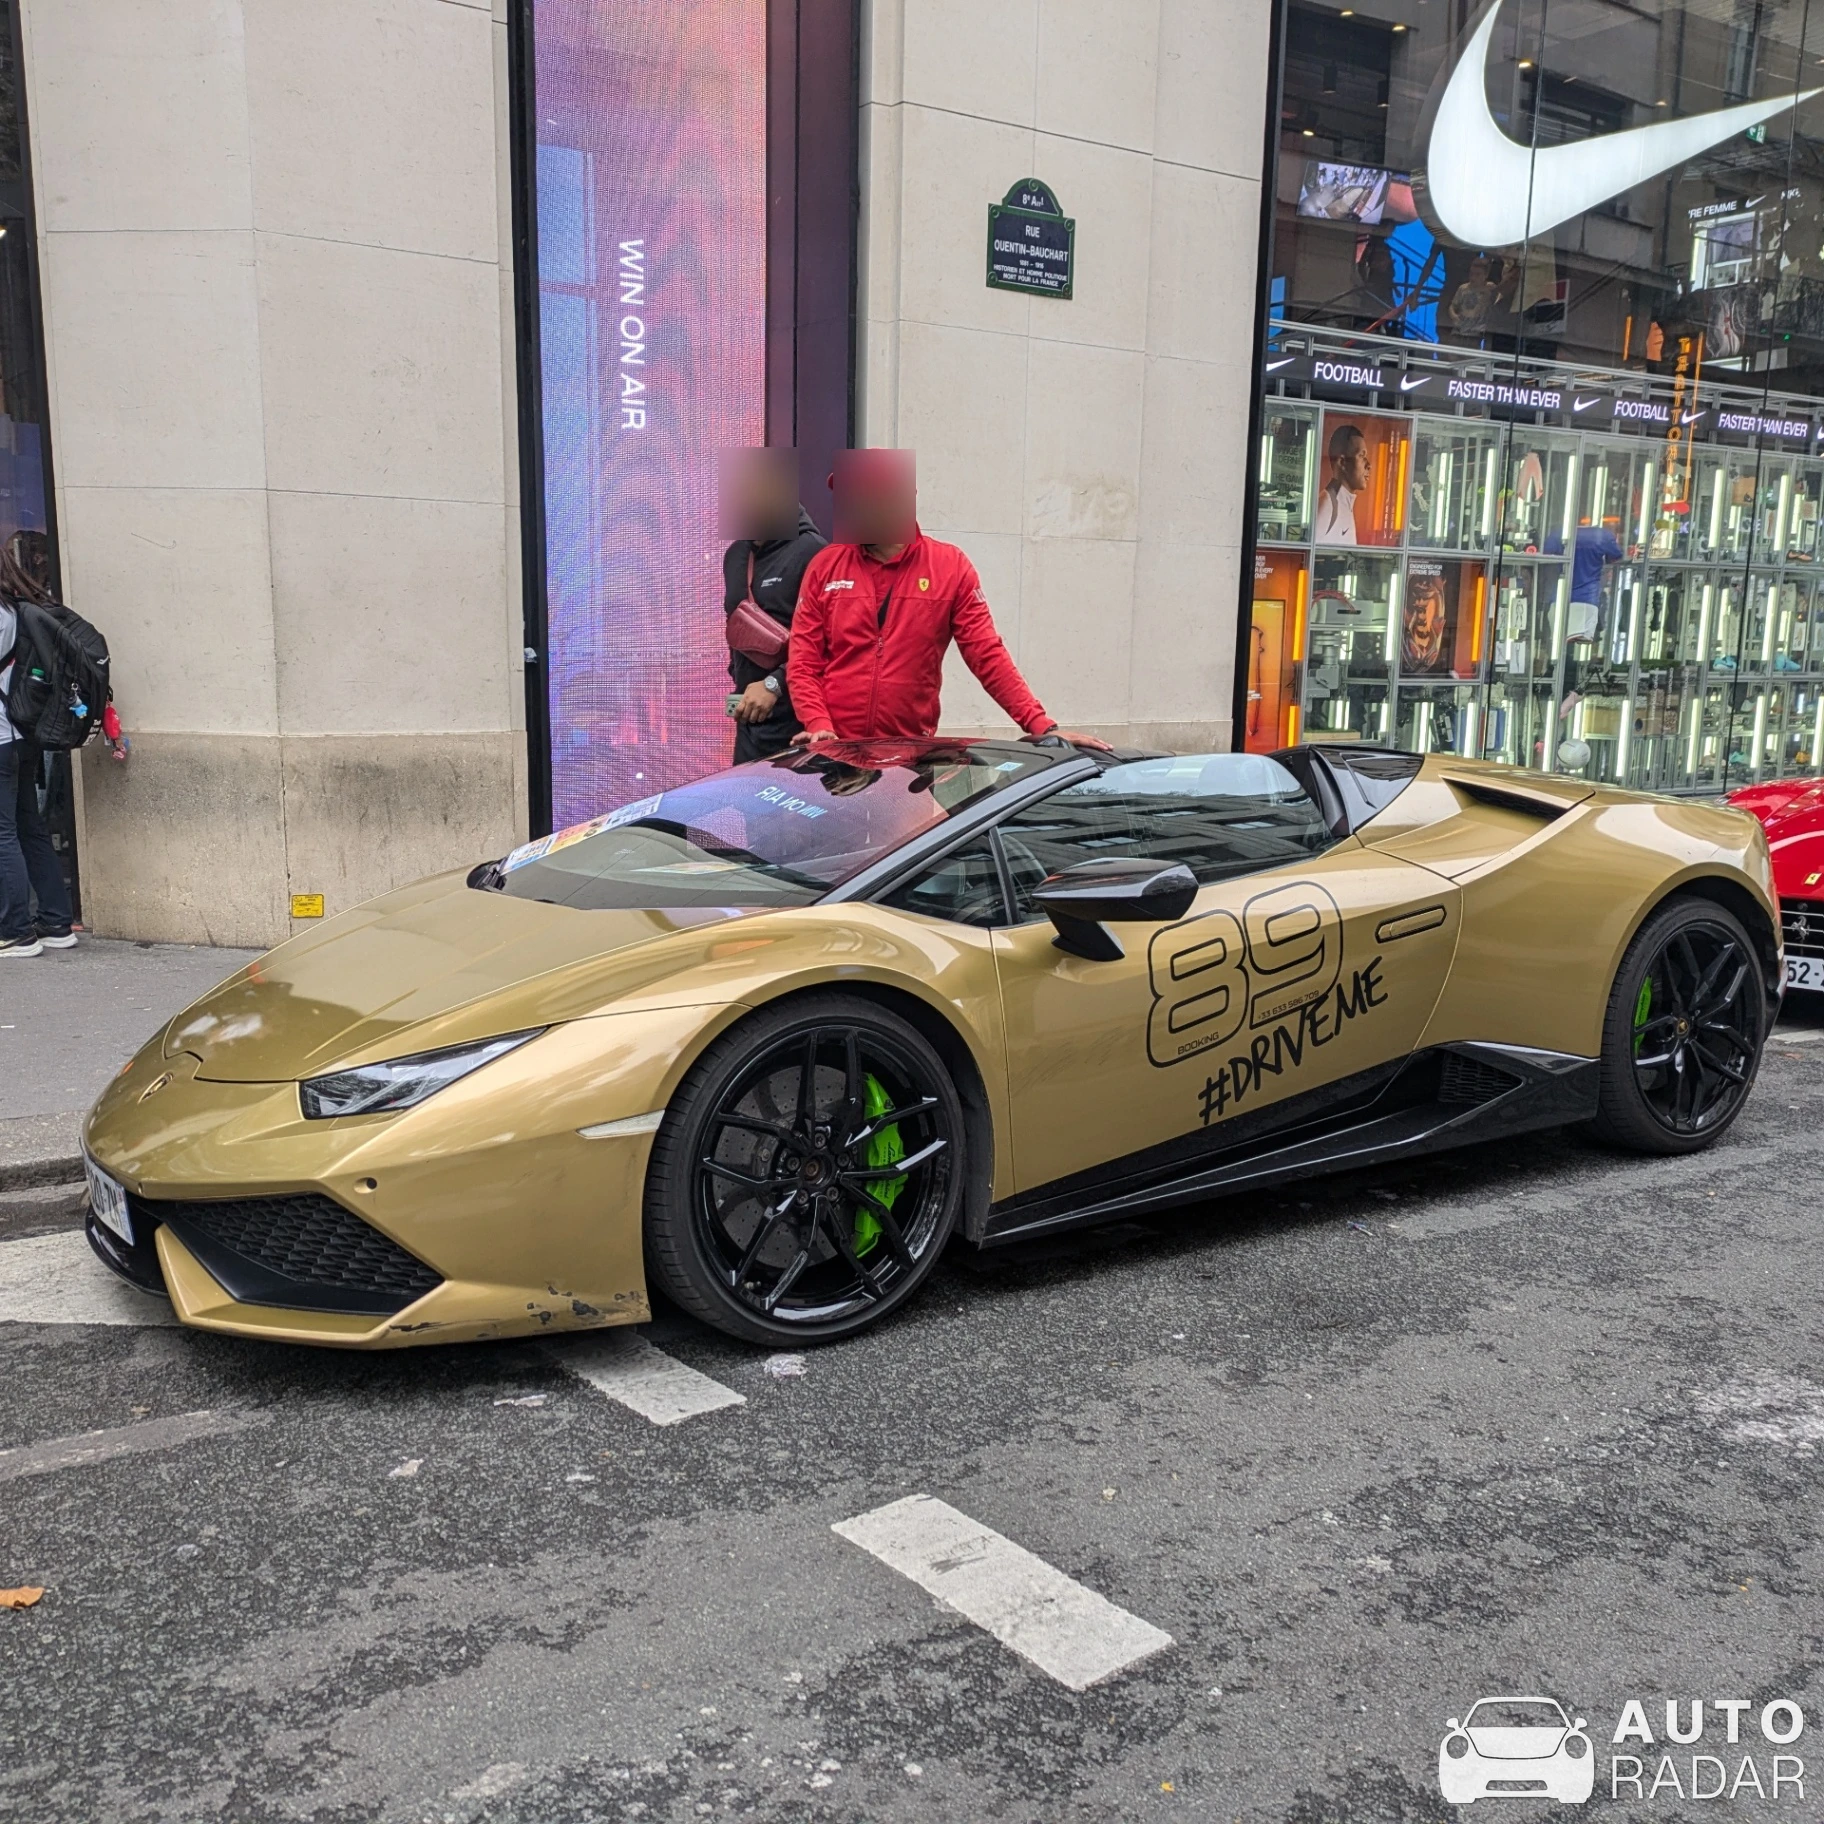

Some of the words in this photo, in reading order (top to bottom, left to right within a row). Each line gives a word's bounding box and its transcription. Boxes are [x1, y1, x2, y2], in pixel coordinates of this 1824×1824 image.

[1703, 200, 1737, 216] FEMME
[1025, 225, 1041, 238] RUE
[994, 239, 1069, 262] QUENTIN-BAUCHART
[618, 239, 645, 305] WIN
[993, 264, 1018, 273] HISTORIEN
[1019, 267, 1025, 275] ET
[1018, 274, 1031, 282] POUR
[1040, 278, 1059, 287] FRANCE
[619, 315, 645, 365] ON
[1314, 361, 1384, 387] FOOTBALL
[620, 373, 646, 430] AIR
[1448, 380, 1494, 401] FASTER
[1530, 391, 1561, 409] EVER
[1614, 400, 1669, 421] FOOTBALL
[1718, 413, 1755, 431] FASTER
[1782, 422, 1808, 438] EVER
[1147, 880, 1344, 1069] 89
[1272, 1003, 1288, 1015] 633
[1304, 989, 1320, 1001] 709
[1177, 1031, 1220, 1056] BOOKING
[1197, 955, 1389, 1126] #DRIVEME
